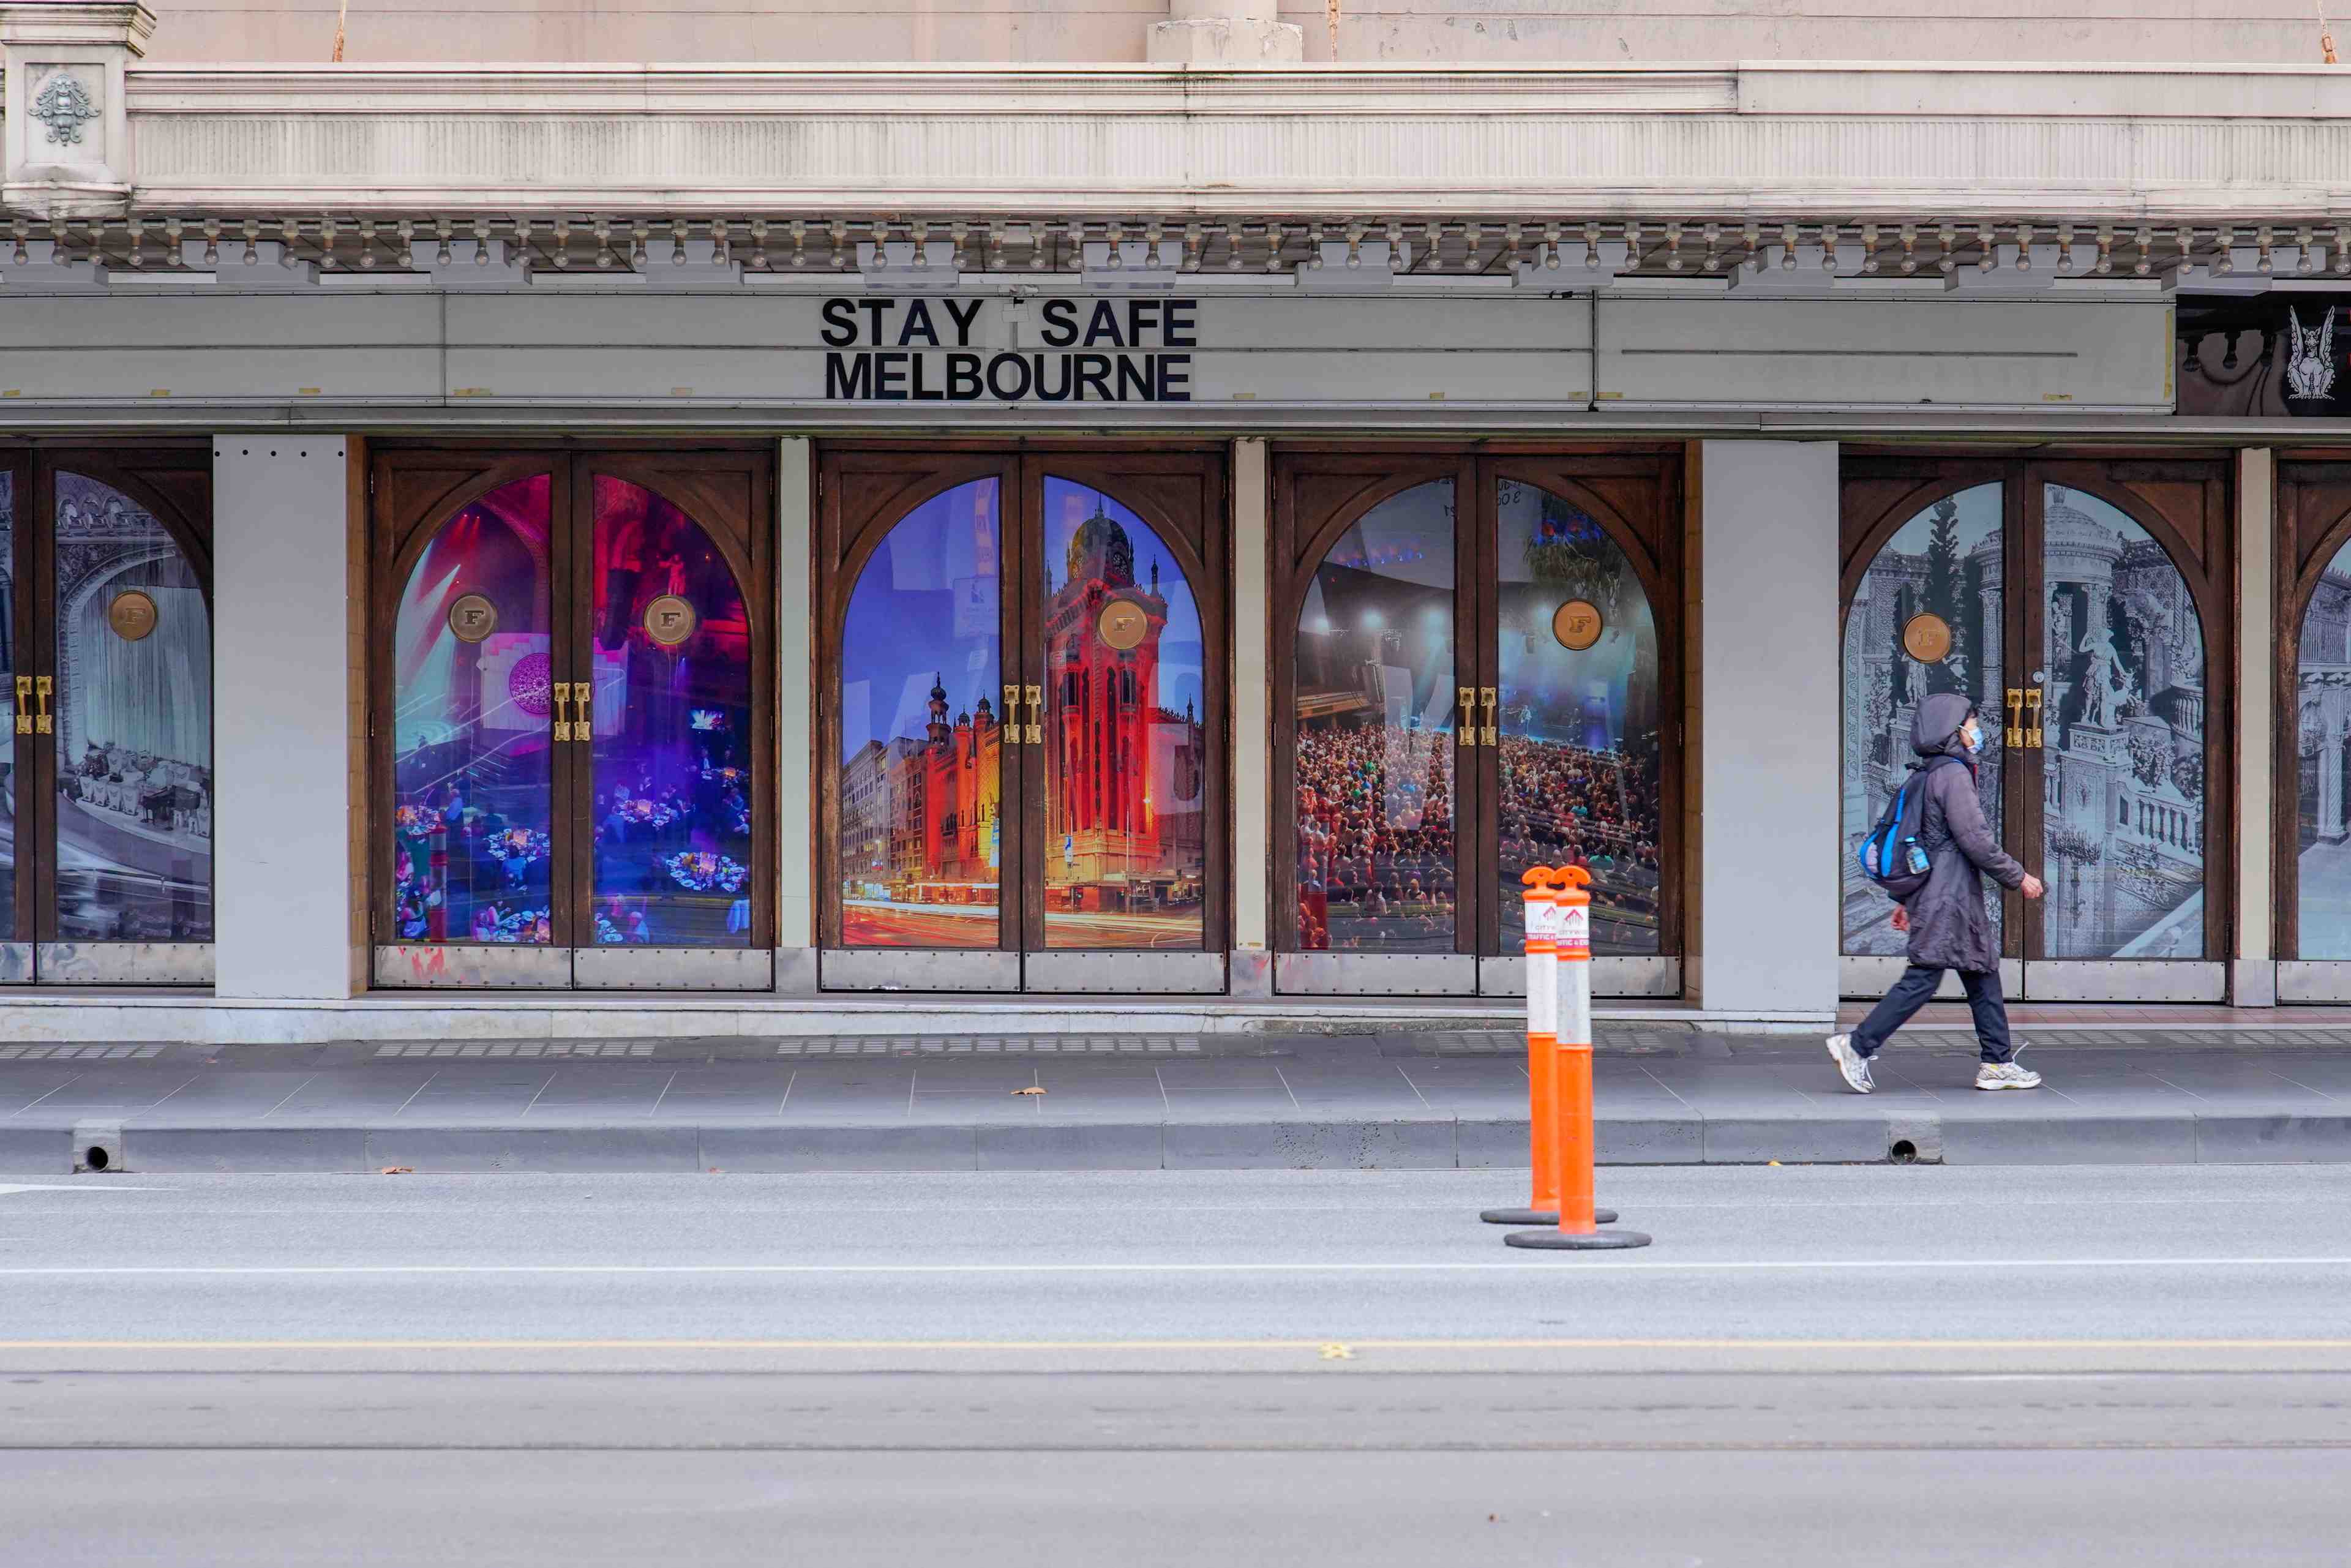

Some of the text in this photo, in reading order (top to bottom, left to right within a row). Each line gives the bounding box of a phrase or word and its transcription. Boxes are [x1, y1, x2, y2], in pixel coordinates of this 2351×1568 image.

[821, 298, 1197, 348] STAY SAFE
[827, 353, 1191, 401] MELBOURNE
[122, 607, 147, 627] F
[465, 610, 484, 625] F
[661, 612, 681, 628] F
[1569, 615, 1592, 633] F
